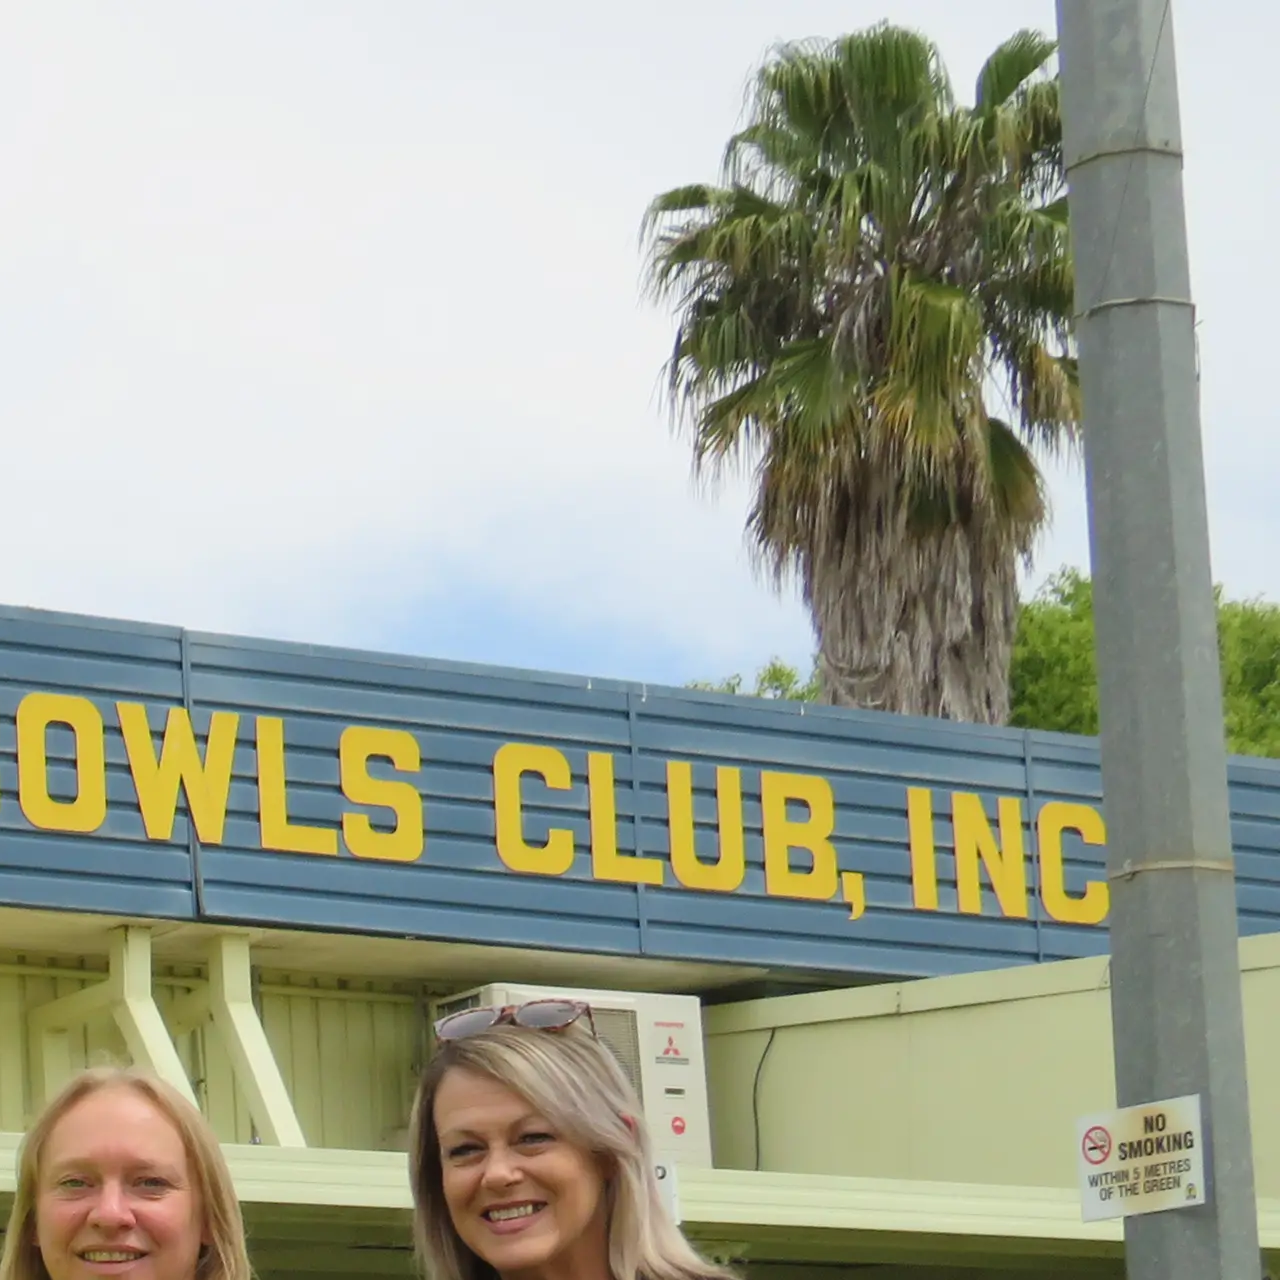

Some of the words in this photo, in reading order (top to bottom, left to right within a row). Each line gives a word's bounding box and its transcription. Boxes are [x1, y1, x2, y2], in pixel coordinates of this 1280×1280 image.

[493, 742, 865, 920] CLUB,
[907, 786, 1110, 924] INC
[1143, 1113, 1166, 1134] NO
[1118, 1131, 1194, 1161] SMOKING
[1088, 1170, 1129, 1188] WITHIN
[1133, 1167, 1140, 1180] 5
[1144, 1158, 1191, 1178] METRES
[1099, 1187, 1114, 1201] OF
[1118, 1182, 1139, 1197] THE
[1143, 1176, 1181, 1194] GREEN
